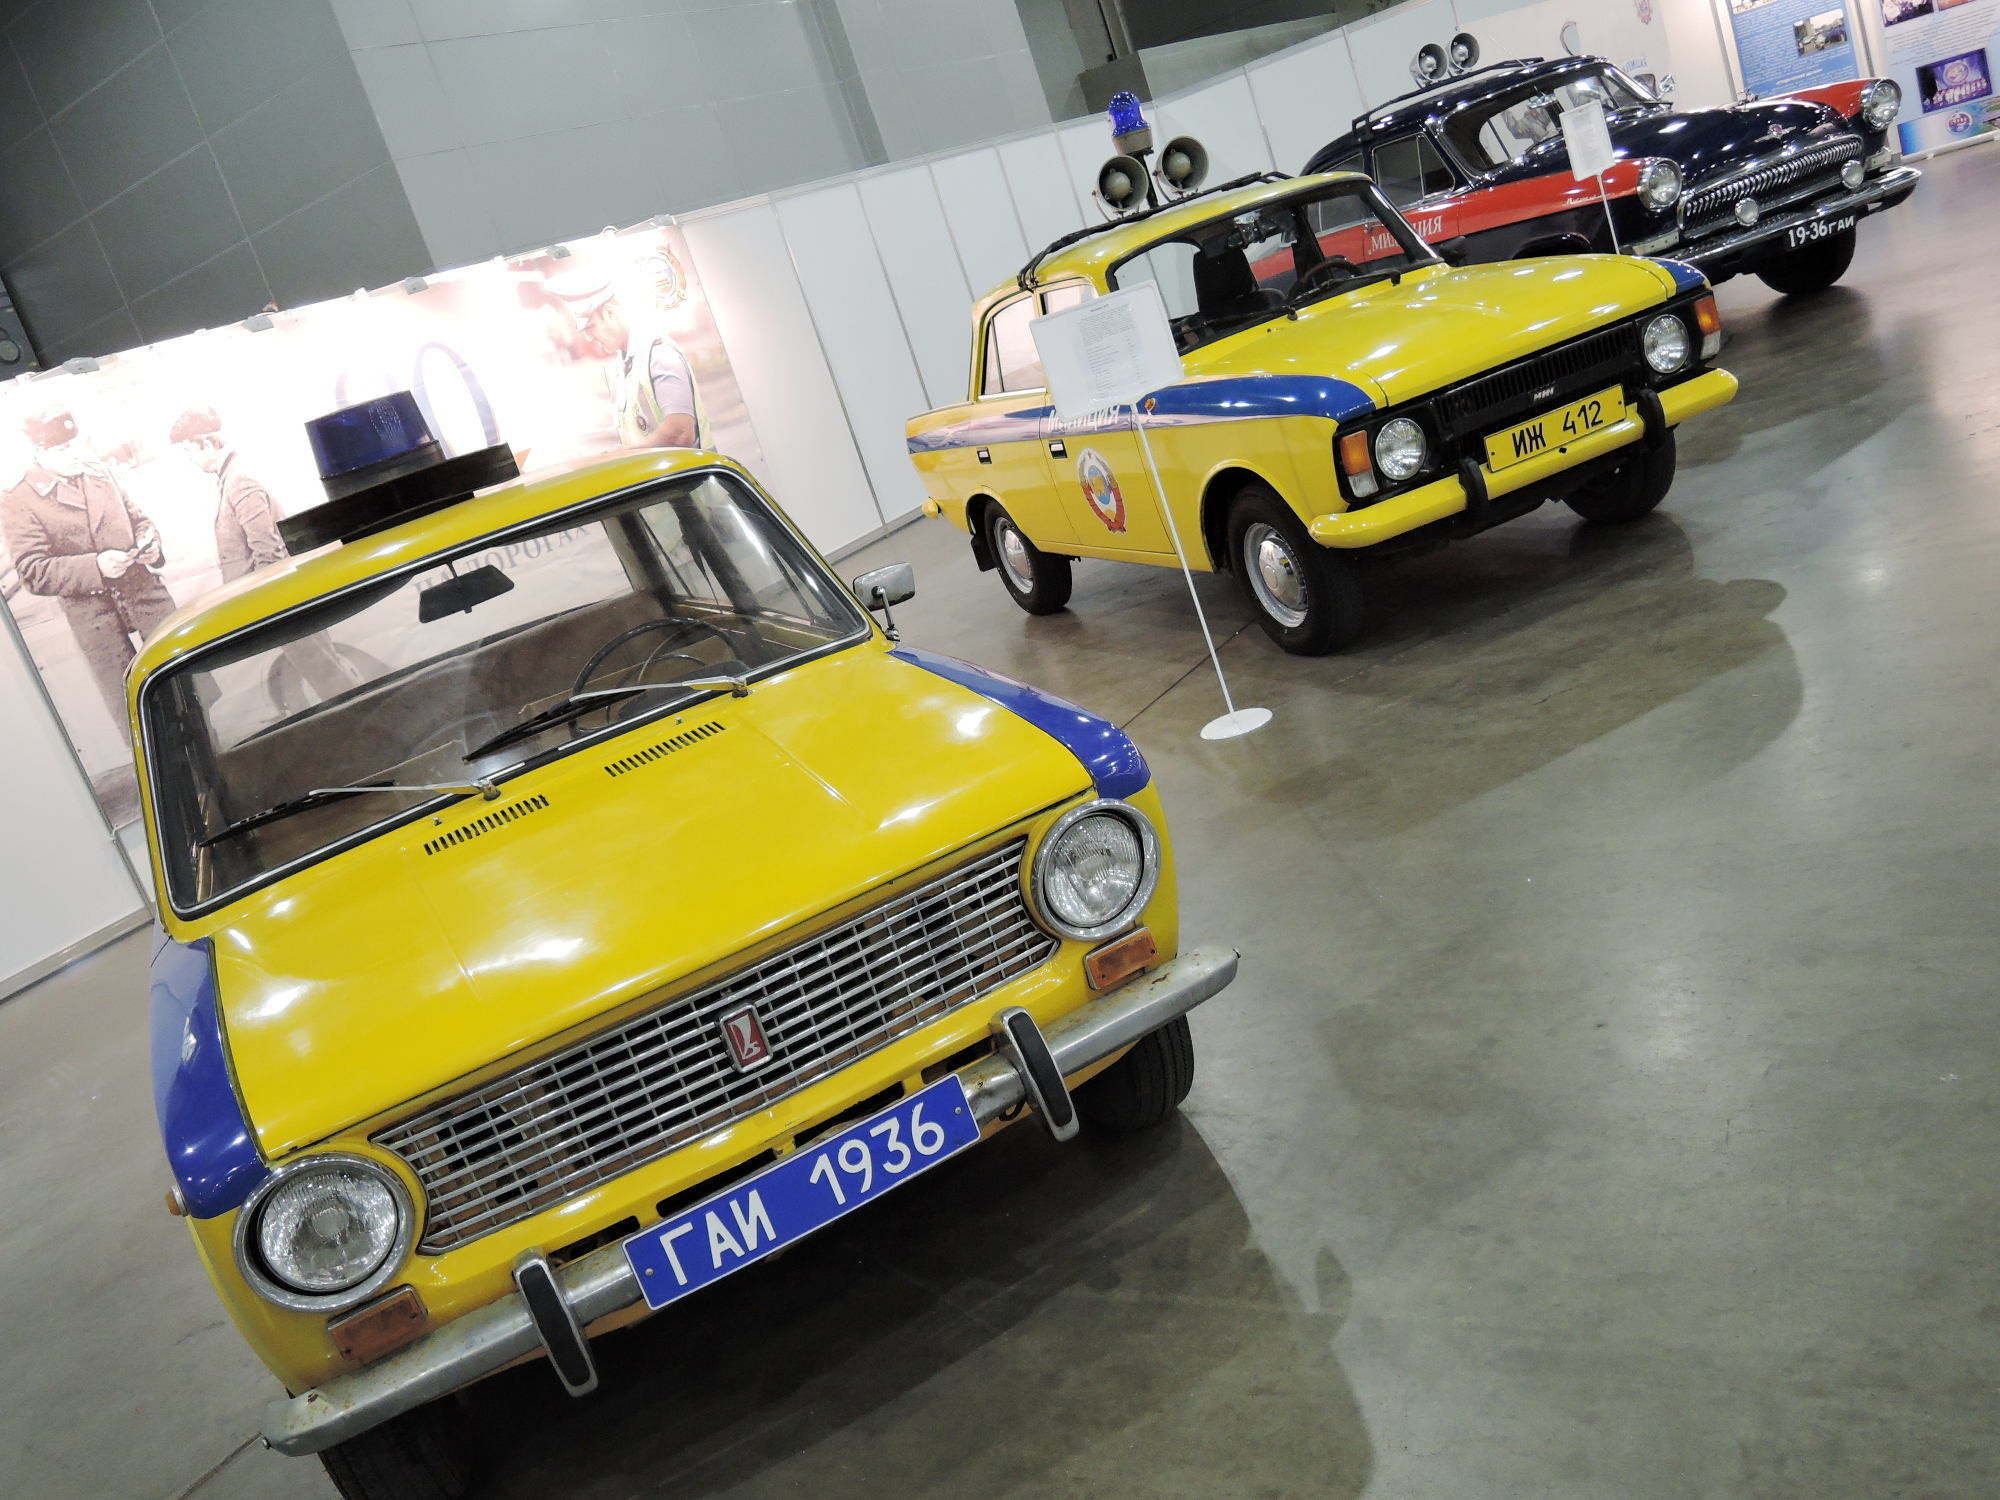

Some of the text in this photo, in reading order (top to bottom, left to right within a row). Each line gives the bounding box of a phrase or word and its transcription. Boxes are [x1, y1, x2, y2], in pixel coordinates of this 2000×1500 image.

[1511, 400, 1604, 457] ИЖ 412
[659, 1102, 945, 1286] ГАИ 1936
